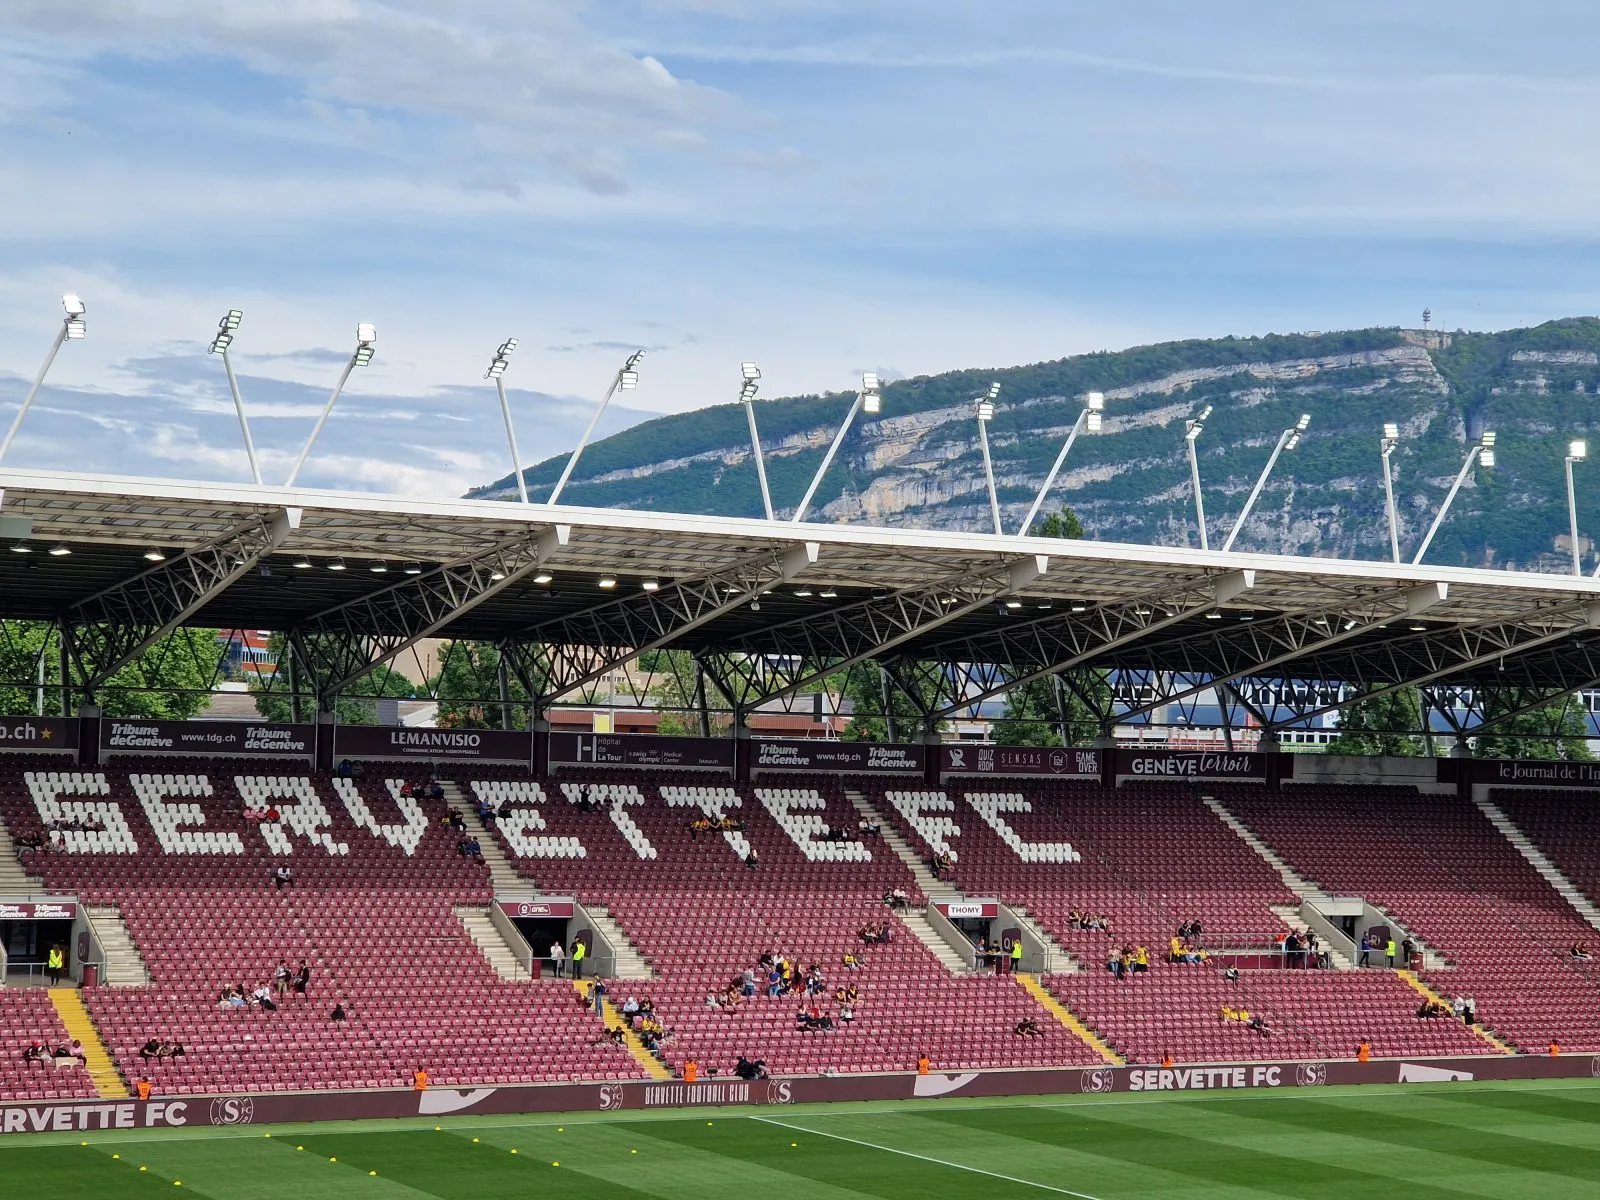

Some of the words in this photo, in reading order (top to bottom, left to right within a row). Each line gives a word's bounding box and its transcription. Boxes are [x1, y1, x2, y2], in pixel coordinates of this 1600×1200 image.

[111, 723, 159, 735] Tribune
[246, 727, 292, 739] Tribune
[181, 734, 236, 743] www.tdg.ch
[391, 731, 481, 747] LEMANVISIO
[760, 744, 799, 755] Tribune
[869, 747, 906, 758] Tribune
[978, 749, 994, 761] QUIZ
[816, 753, 861, 762] www.tdg.ch
[1001, 753, 1041, 765] SENSAS
[1075, 751, 1096, 764] GAME
[977, 761, 994, 772] ROOM
[1078, 761, 1098, 773] OVER
[1131, 755, 1197, 775] GENÈVE
[1560, 765, 1576, 779] de
[1129, 1067, 1246, 1091] SERVETTE
[1252, 1066, 1281, 1087] FC
[0, 1103, 136, 1133] RVETTE
[145, 1101, 188, 1126] FC
